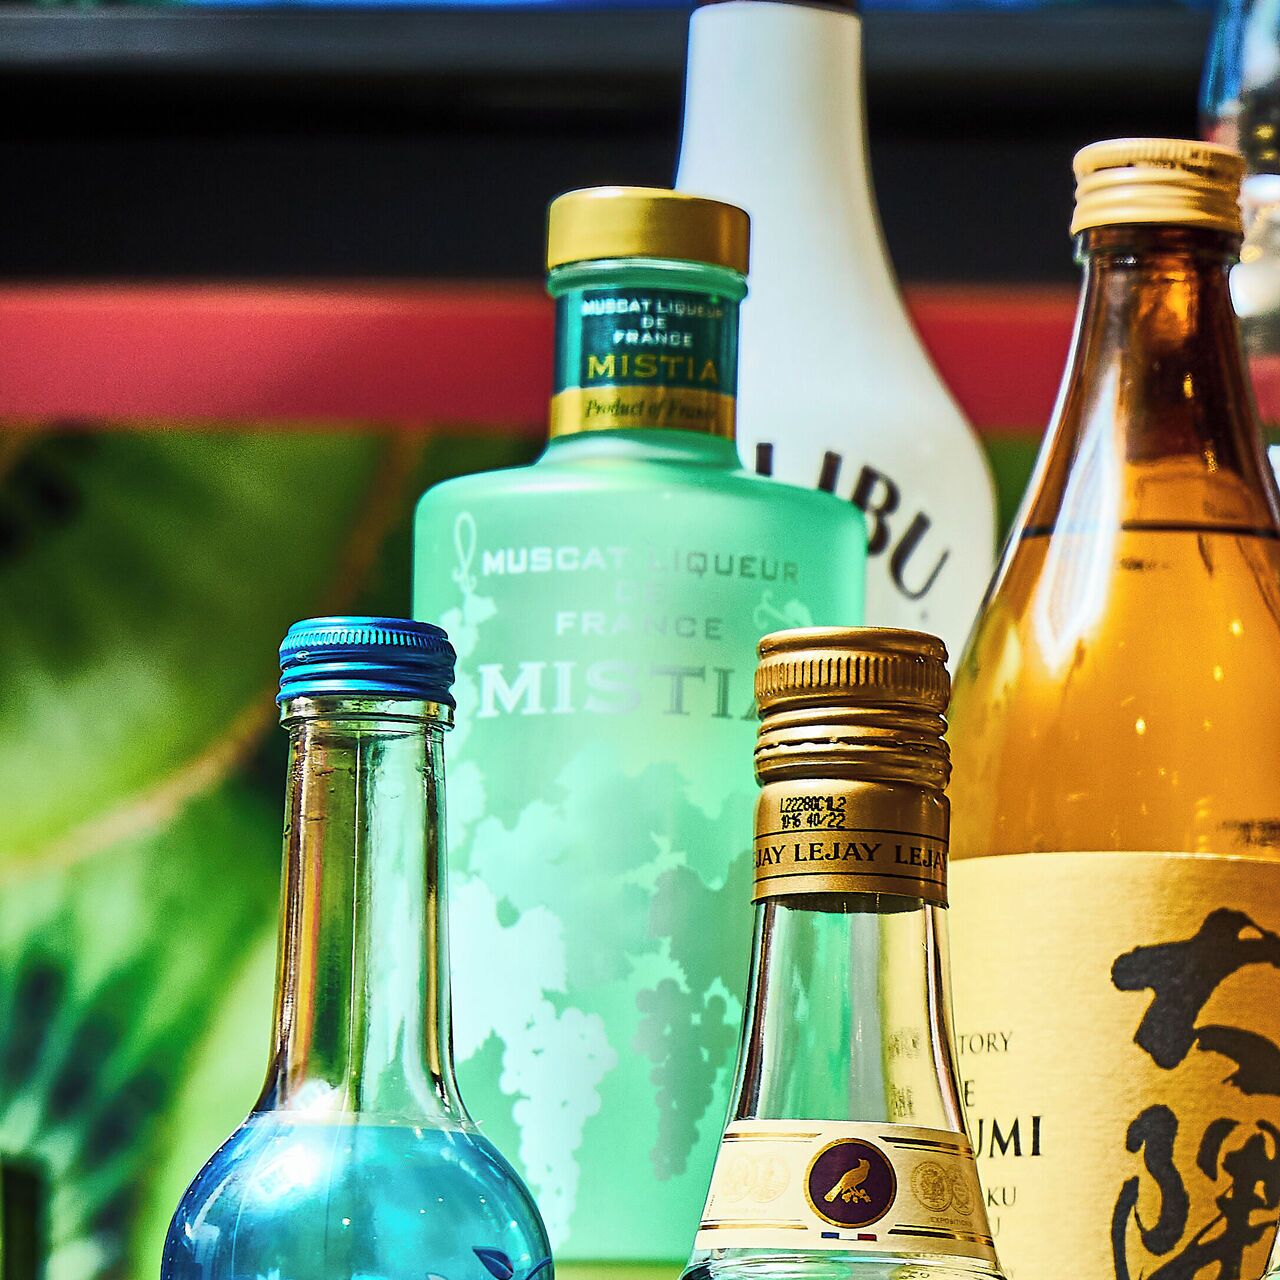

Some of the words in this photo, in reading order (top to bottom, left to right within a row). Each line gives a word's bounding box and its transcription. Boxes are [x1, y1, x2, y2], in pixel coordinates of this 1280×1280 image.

[582, 299, 650, 315] MUSCAT
[641, 315, 666, 328] DE
[613, 330, 693, 346] FRANCE
[587, 355, 717, 383] MISTIA
[754, 443, 951, 600] BU
[483, 549, 623, 576] MUSCAT
[648, 550, 799, 583] LIQUEUR
[556, 615, 723, 640] FRANCE
[794, 842, 881, 862] LEJAY
